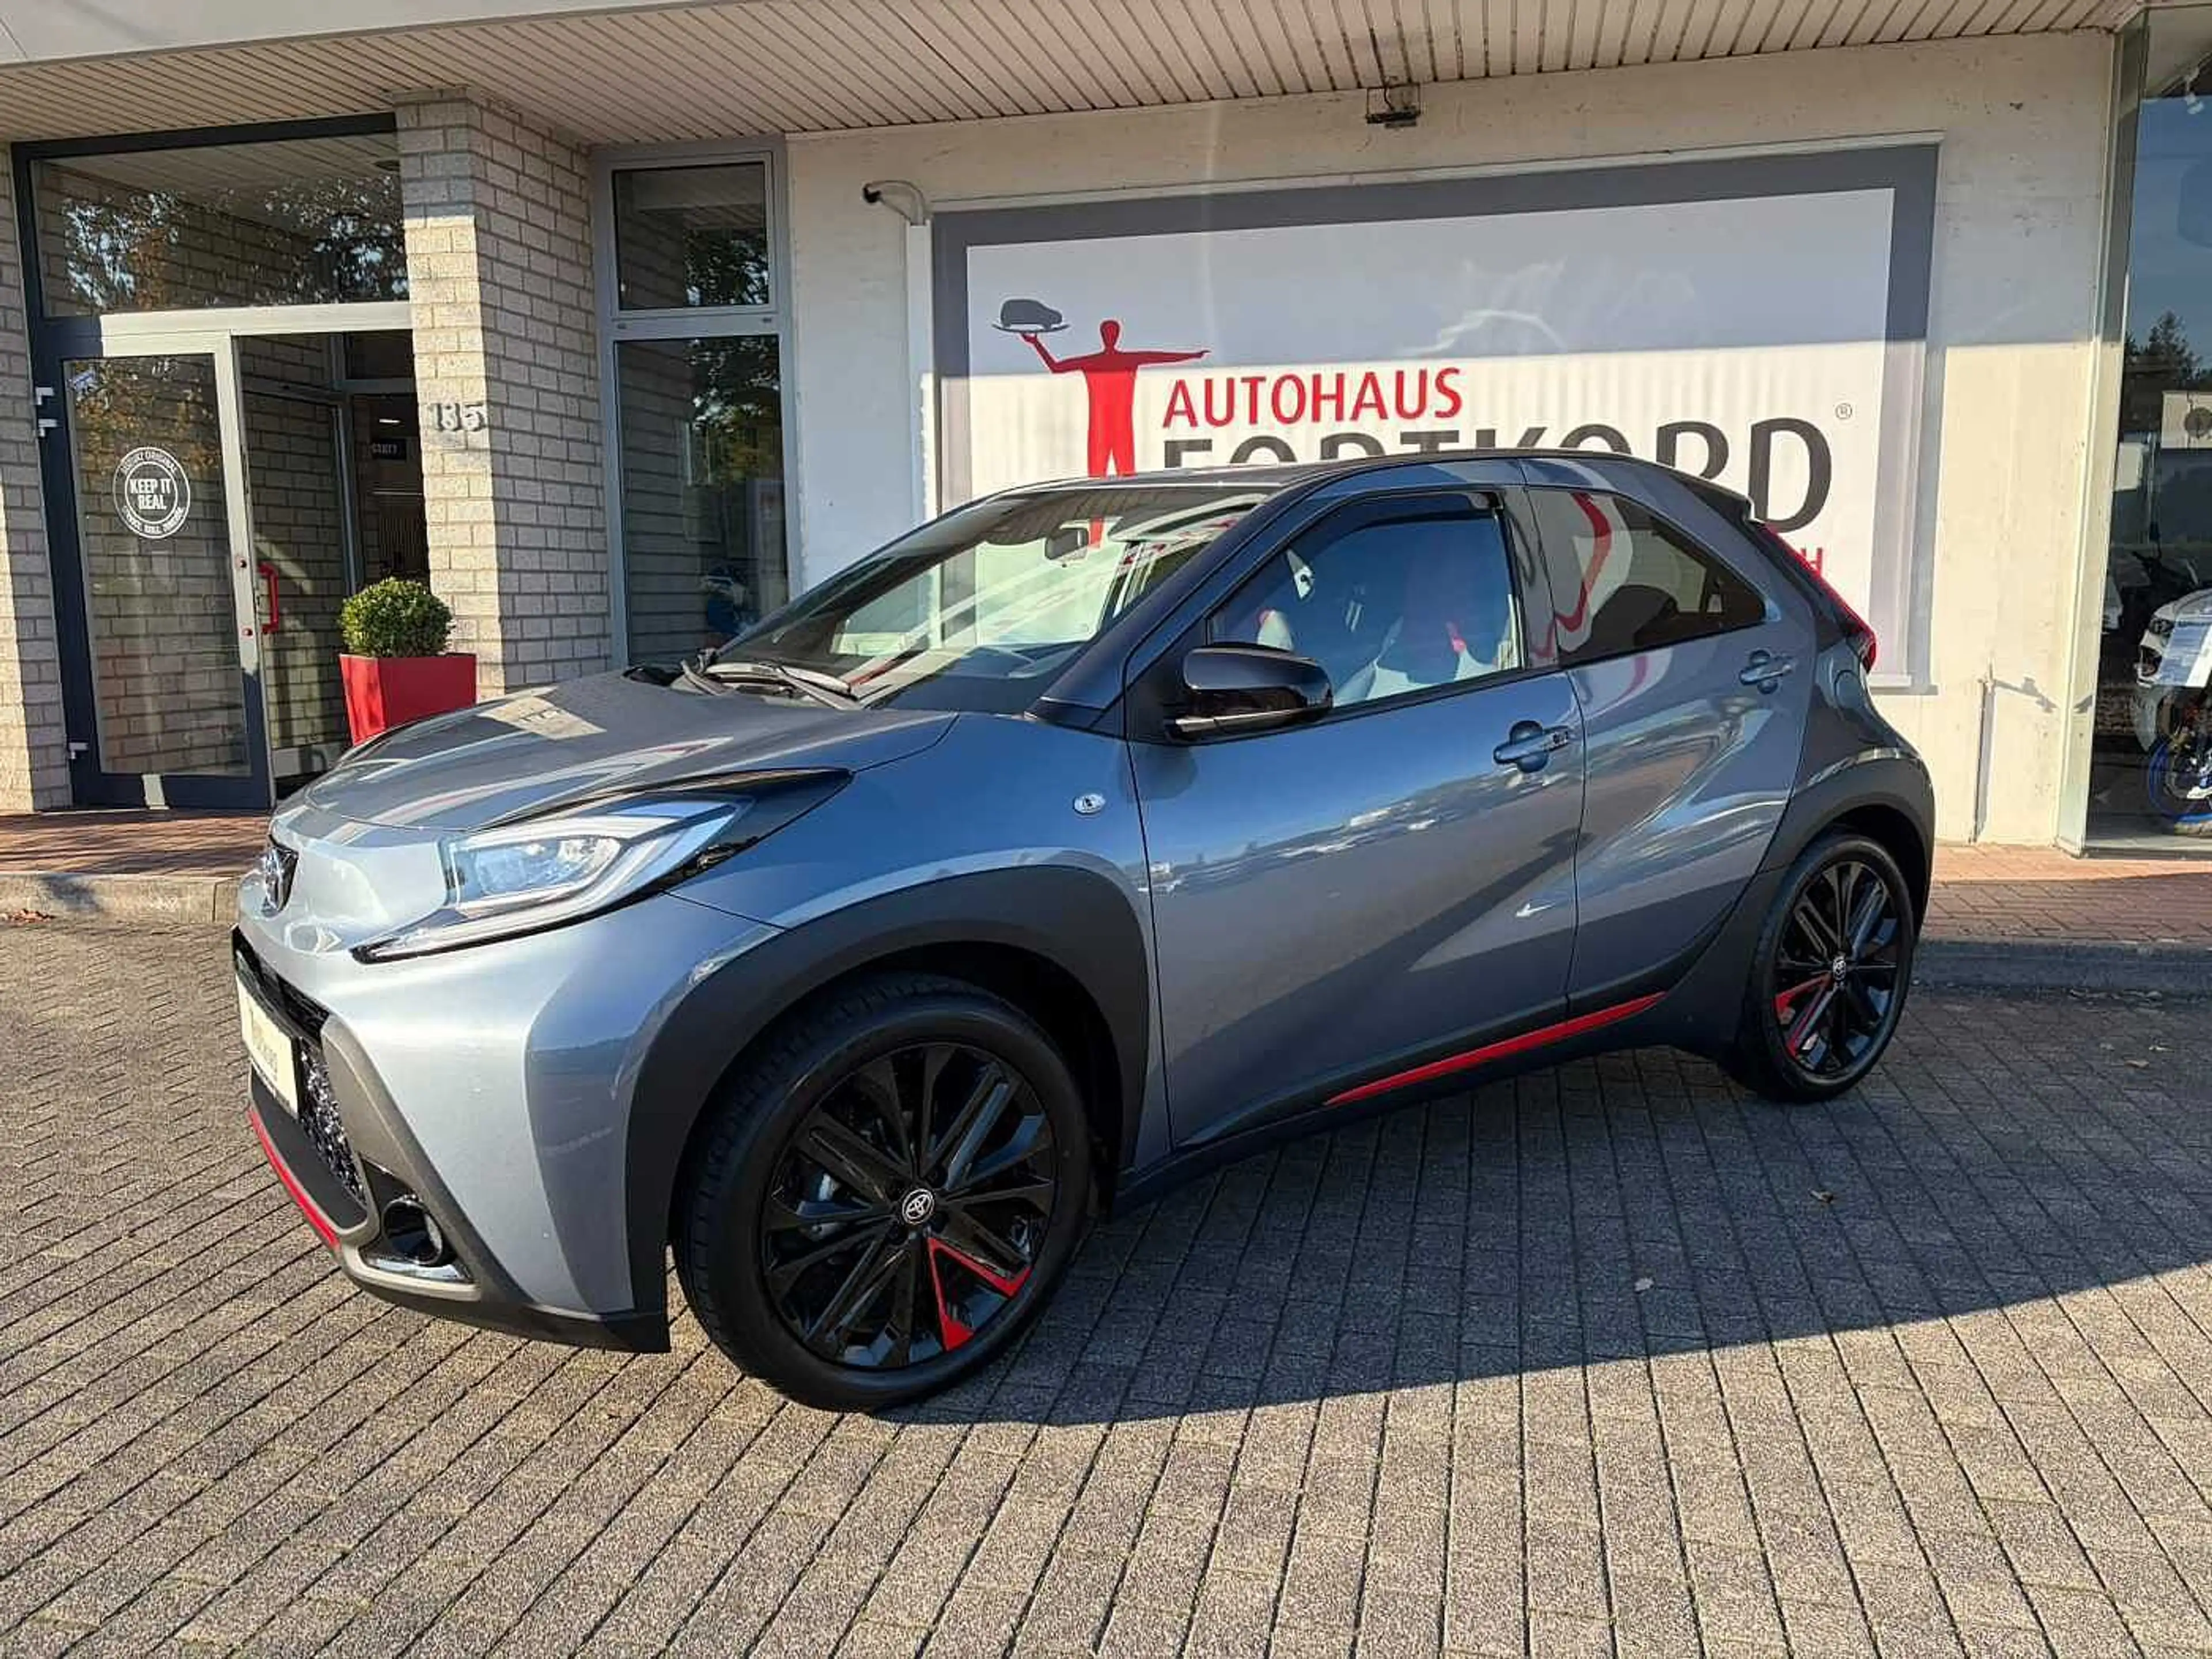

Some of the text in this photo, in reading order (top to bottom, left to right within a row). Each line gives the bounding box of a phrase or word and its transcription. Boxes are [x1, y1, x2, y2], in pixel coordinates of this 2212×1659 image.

[1162, 366, 1463, 428] AUTOHAUS
[130, 478, 172, 494] KEEP IT
[137, 494, 168, 510] REAL
